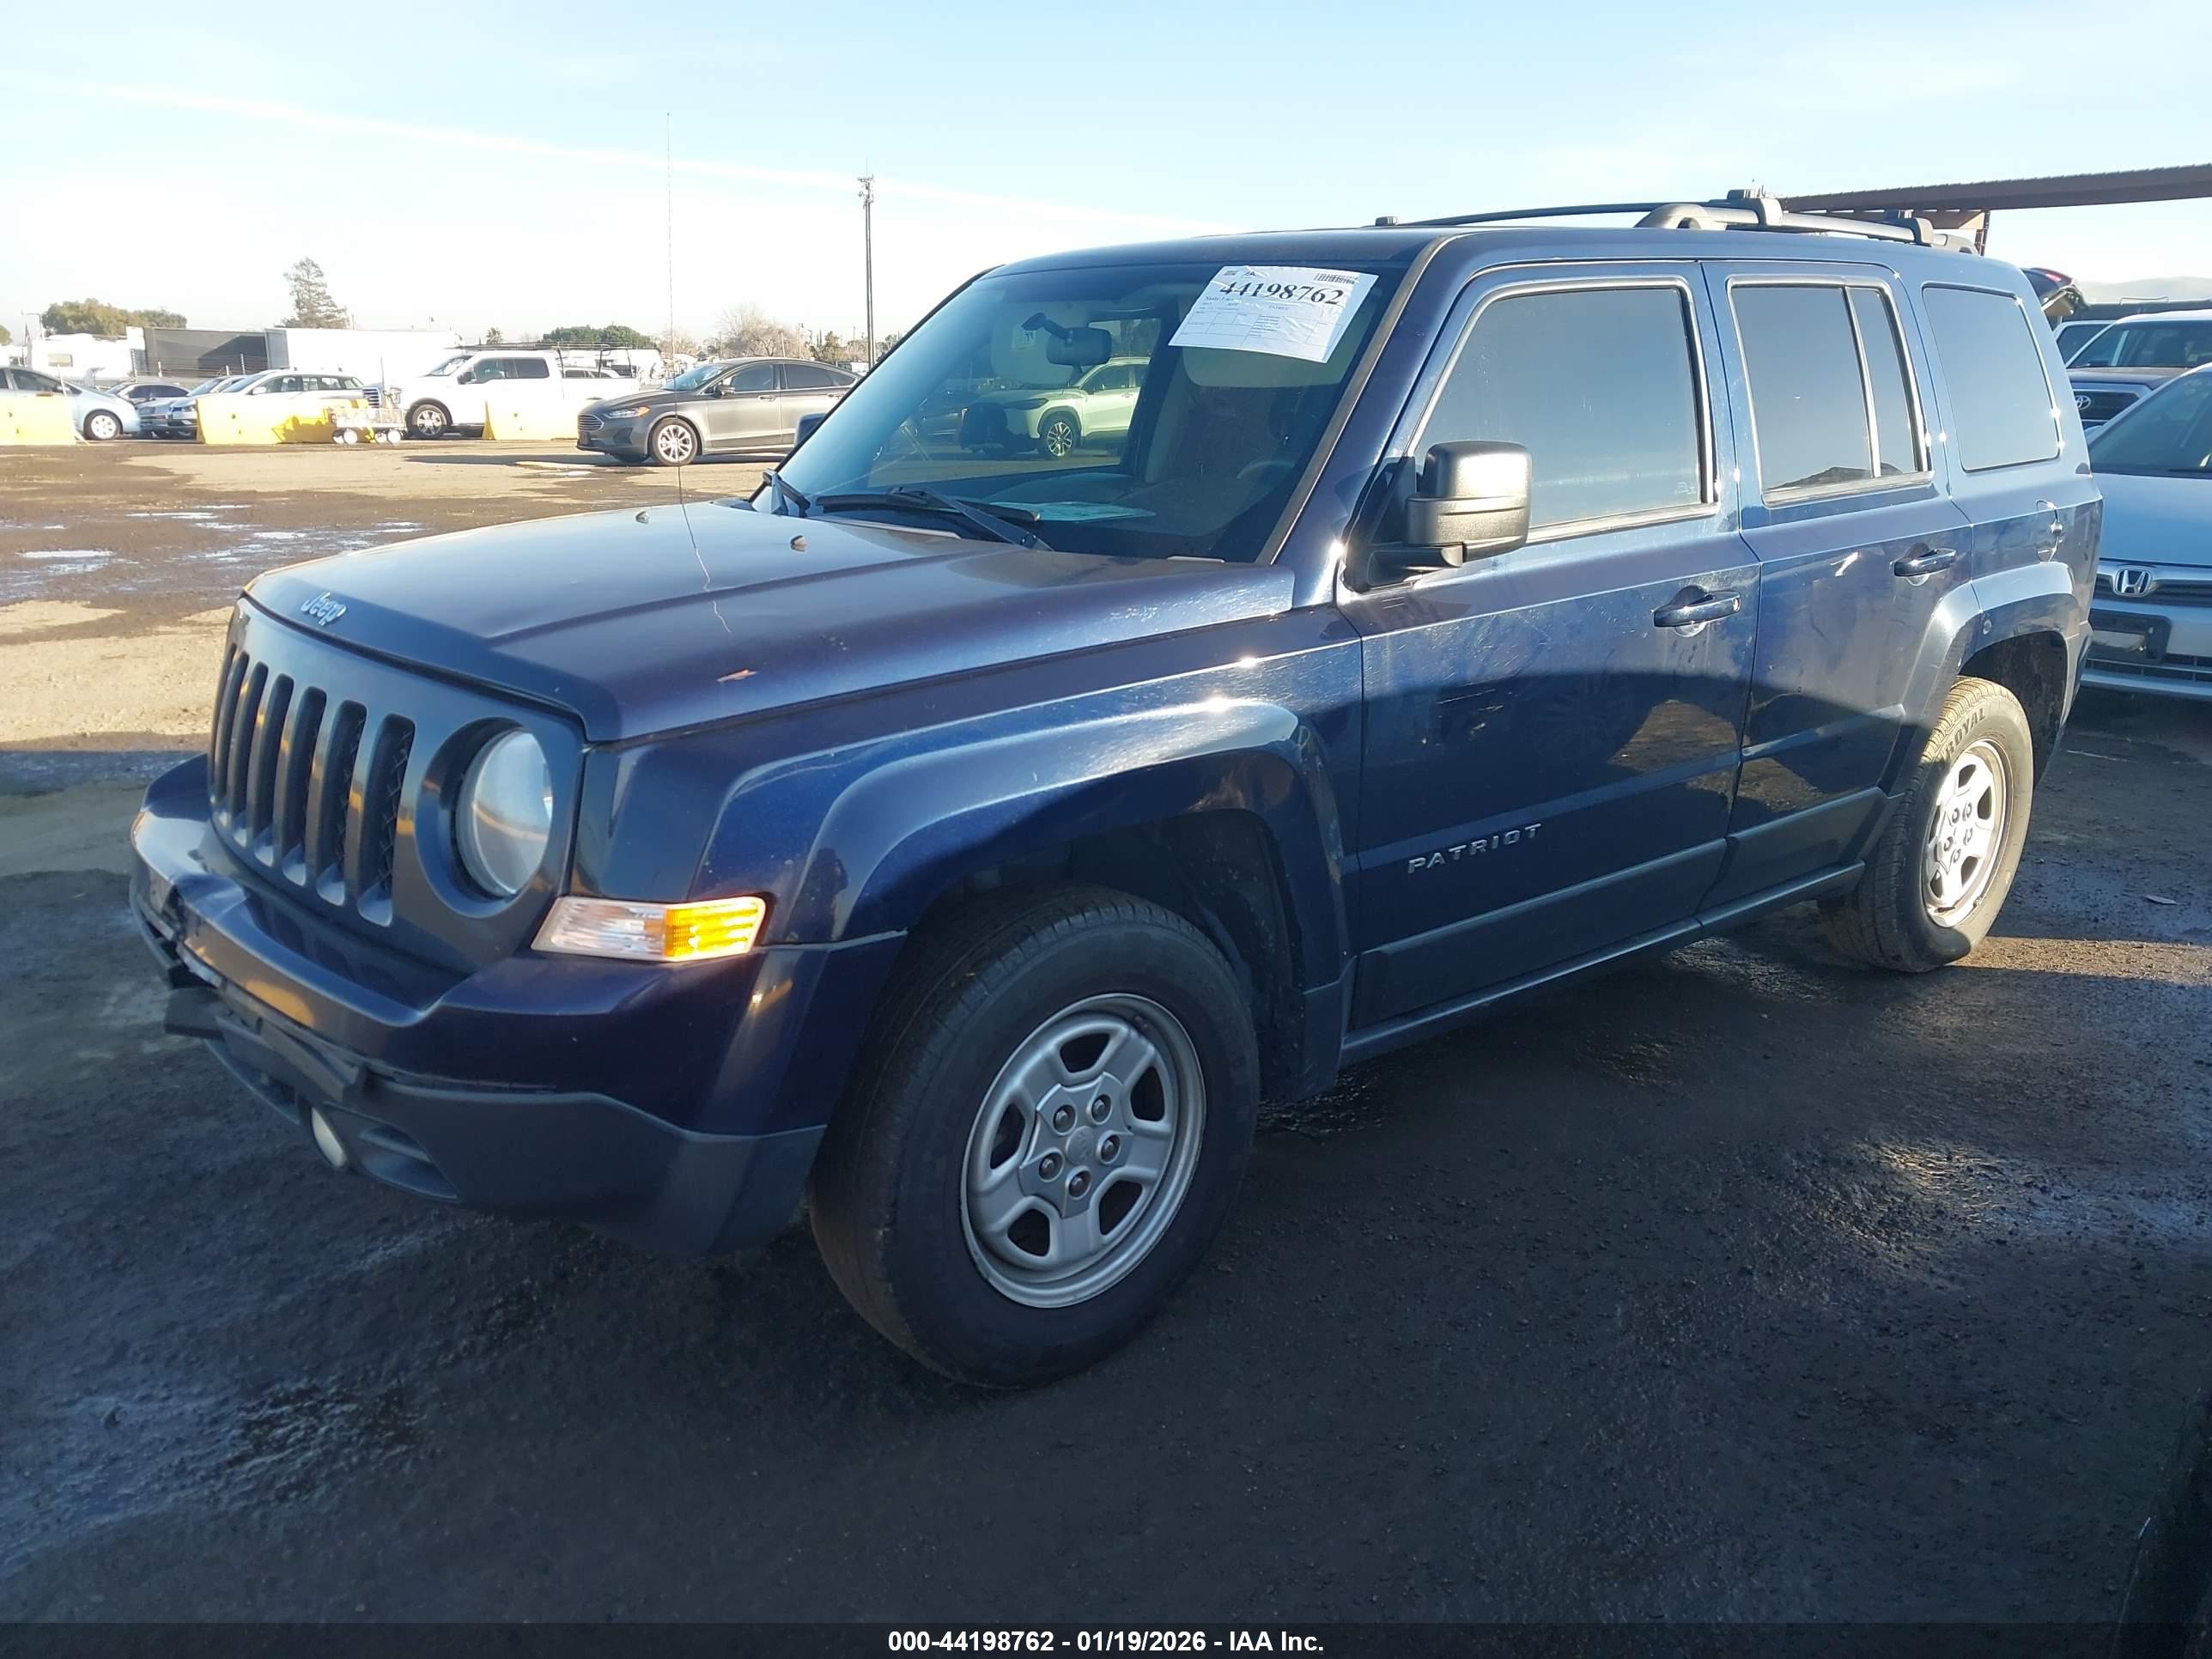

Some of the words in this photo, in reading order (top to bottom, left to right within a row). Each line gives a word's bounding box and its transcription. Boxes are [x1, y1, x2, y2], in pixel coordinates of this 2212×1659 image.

[1219, 281, 1344, 305] 44198762
[301, 592, 347, 626] Jeep
[1407, 823, 1542, 874] PATRIOT
